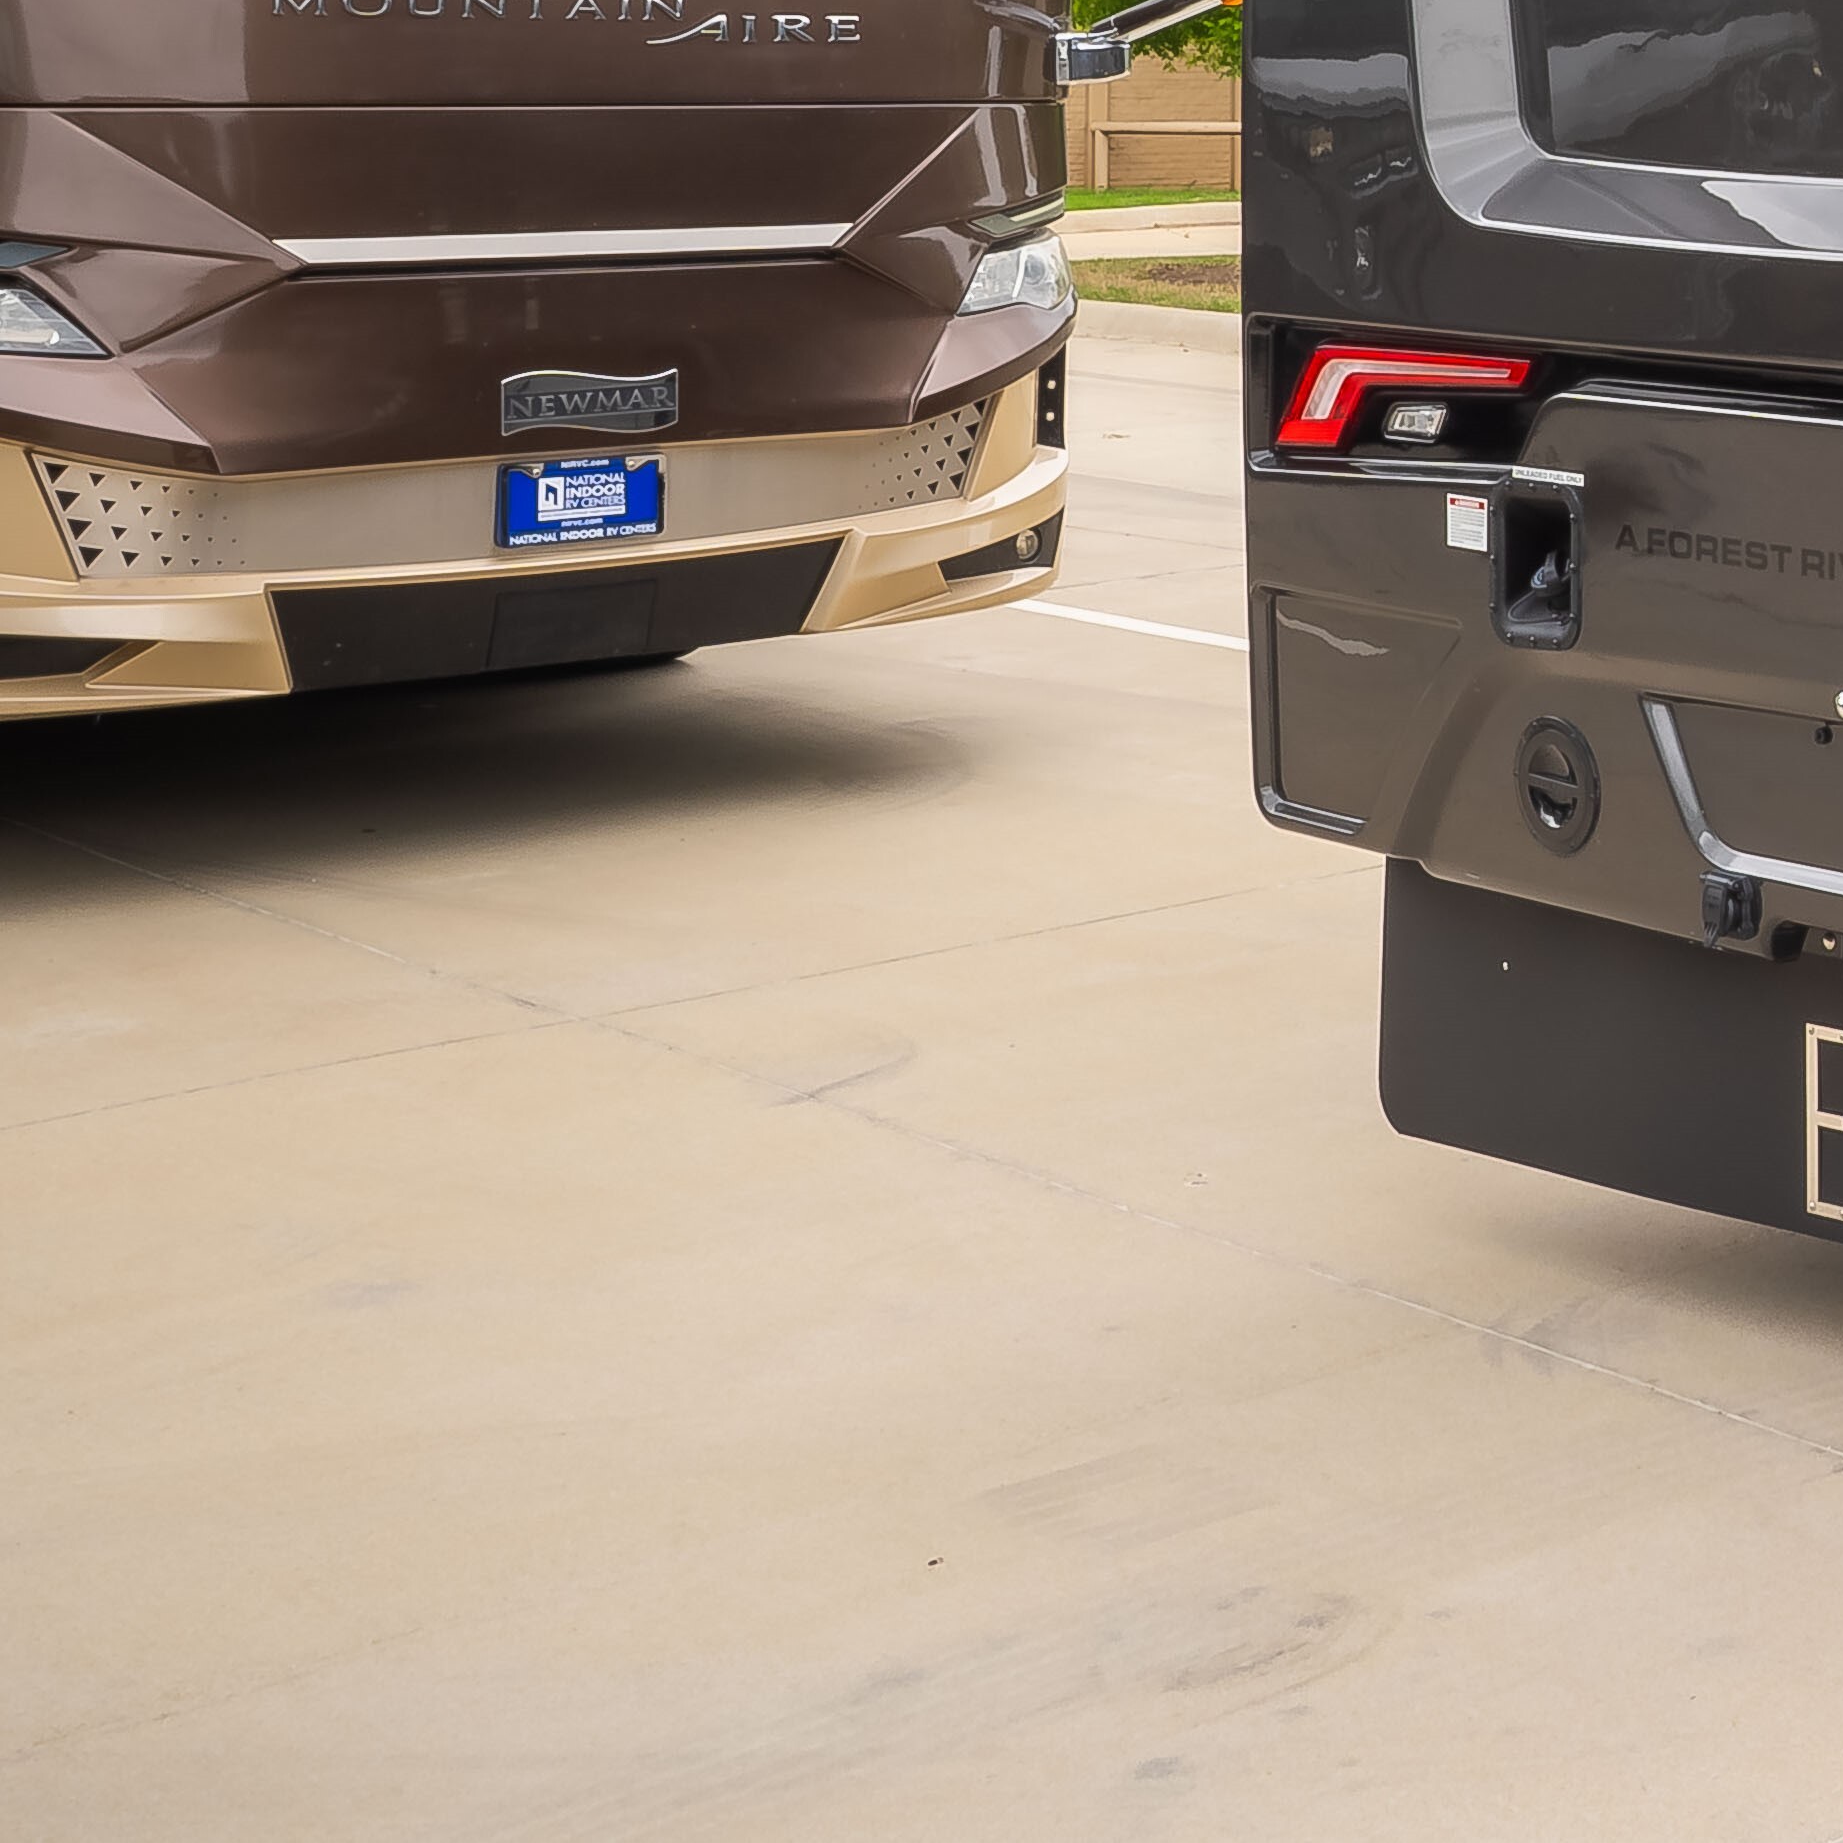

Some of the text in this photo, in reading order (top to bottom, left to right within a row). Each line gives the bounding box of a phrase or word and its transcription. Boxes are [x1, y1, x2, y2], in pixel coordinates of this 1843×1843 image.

[646, 13, 862, 46] AIRE
[507, 386, 675, 420] NEWMAR
[565, 472, 626, 487] NATIONAL
[1549, 472, 1565, 482] FUEL
[565, 483, 626, 499] INDOOR
[565, 495, 626, 509] RV CENTERS
[509, 523, 657, 546] NATIONAL INDOOR RV CENTERS
[1614, 523, 1640, 552] A
[1646, 526, 1793, 574] FOREST
